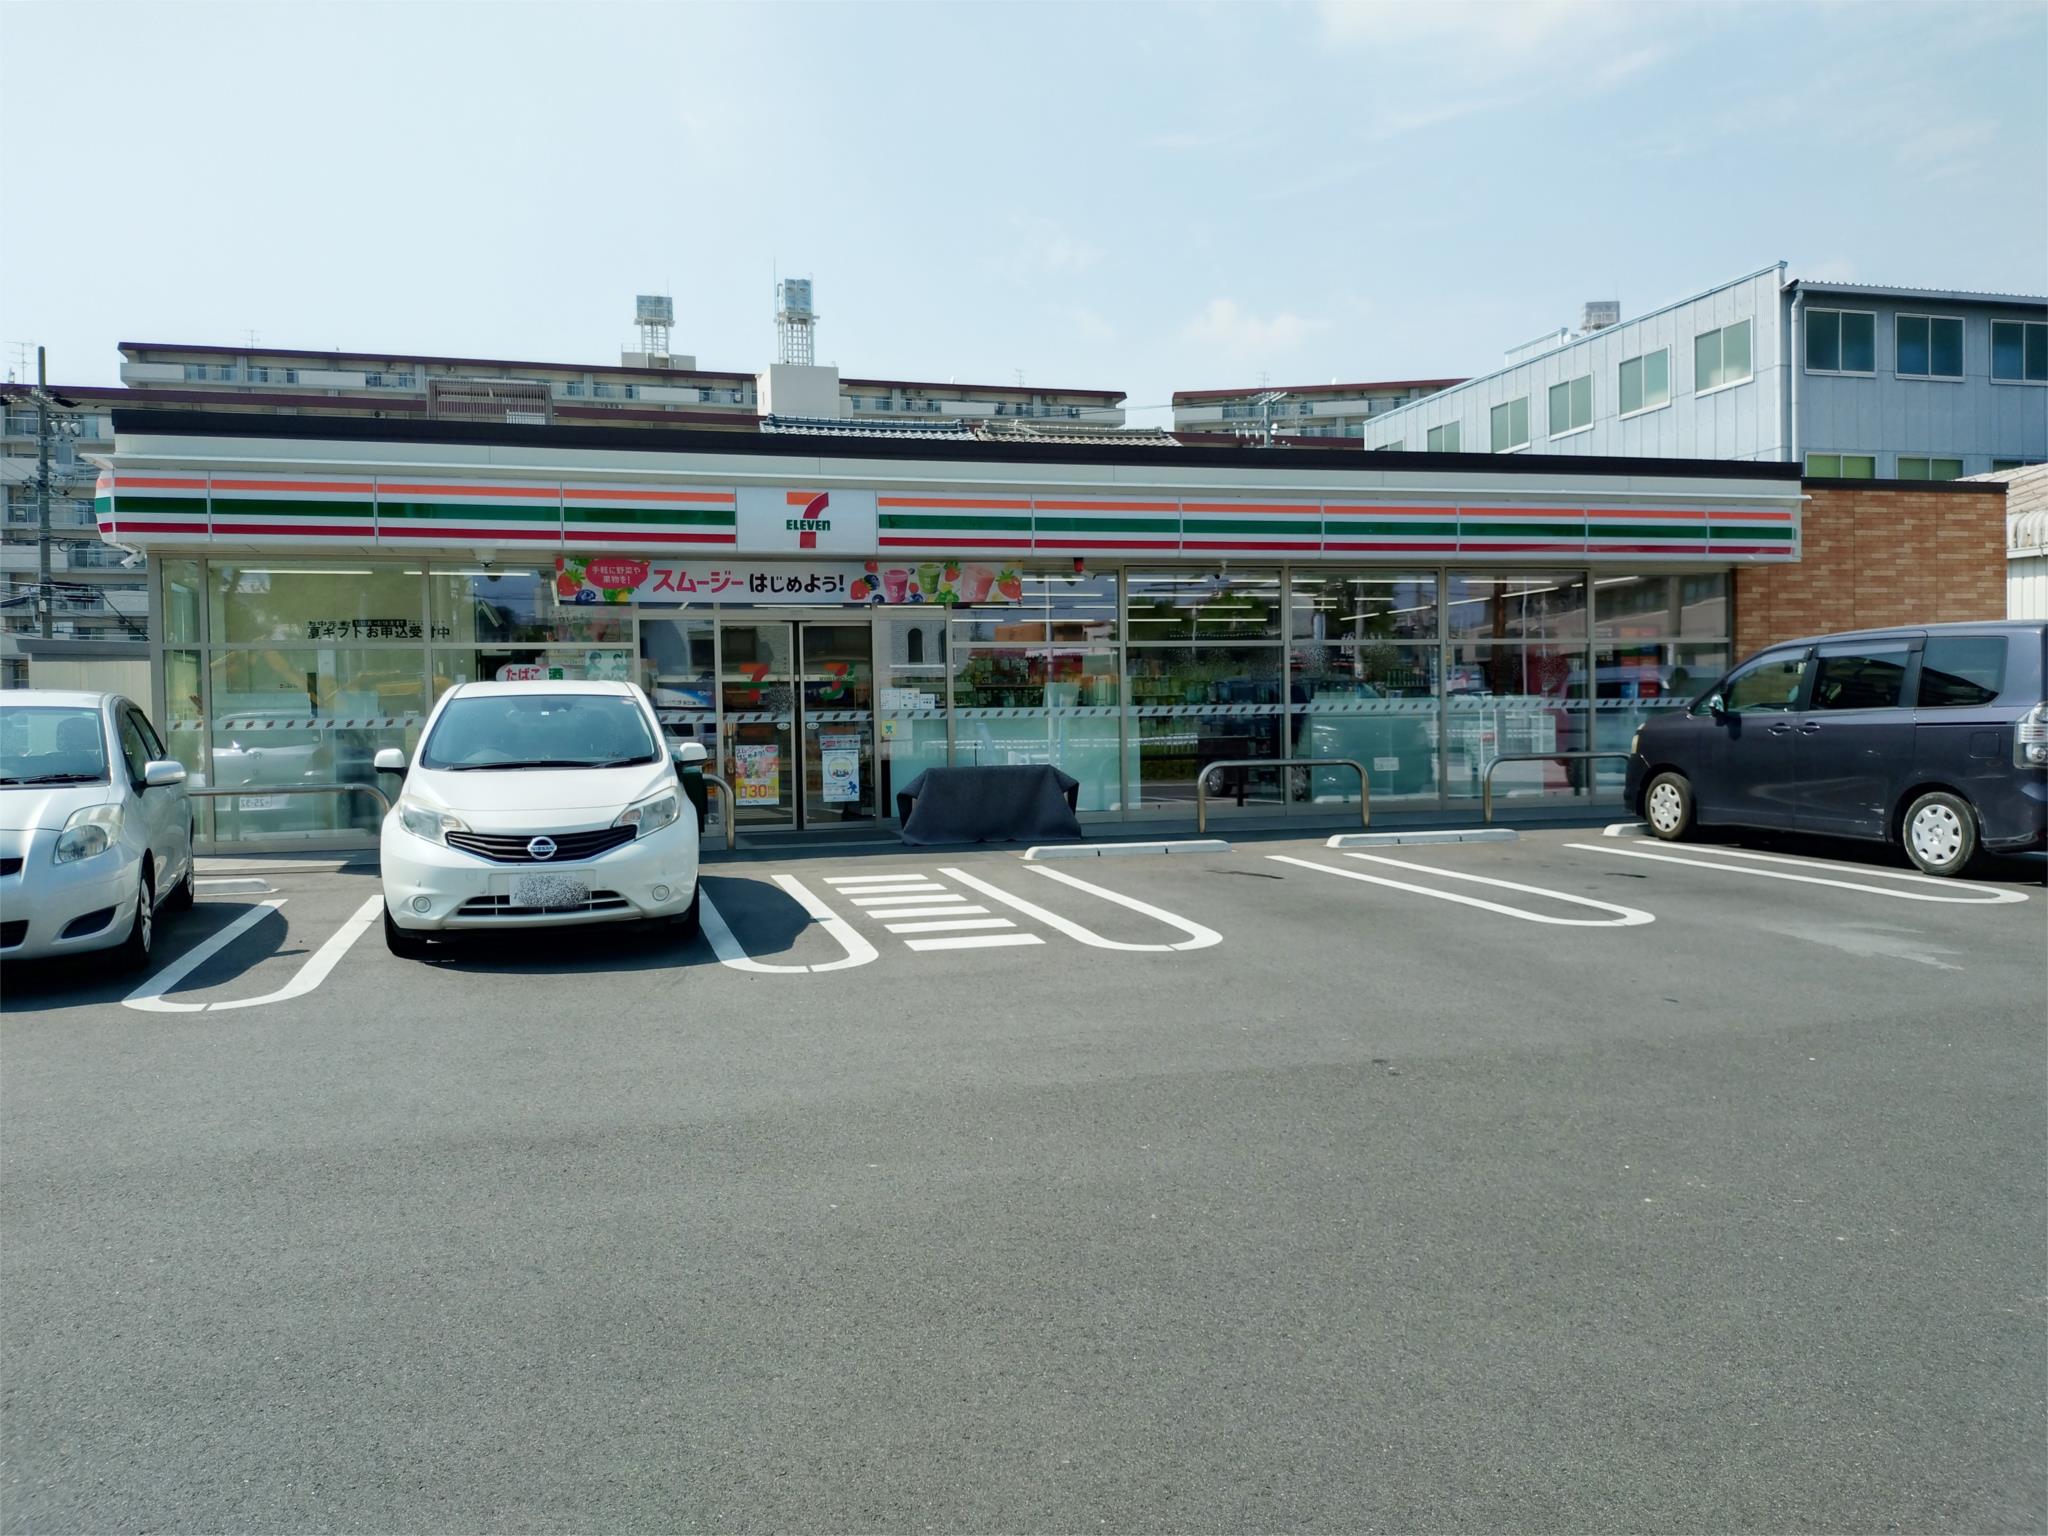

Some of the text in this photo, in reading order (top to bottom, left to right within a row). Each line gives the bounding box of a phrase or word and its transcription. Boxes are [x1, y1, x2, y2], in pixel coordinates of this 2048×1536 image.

[591, 566, 641, 575] 手軽に野菜や
[653, 570, 845, 593] スムージー はじめよう!
